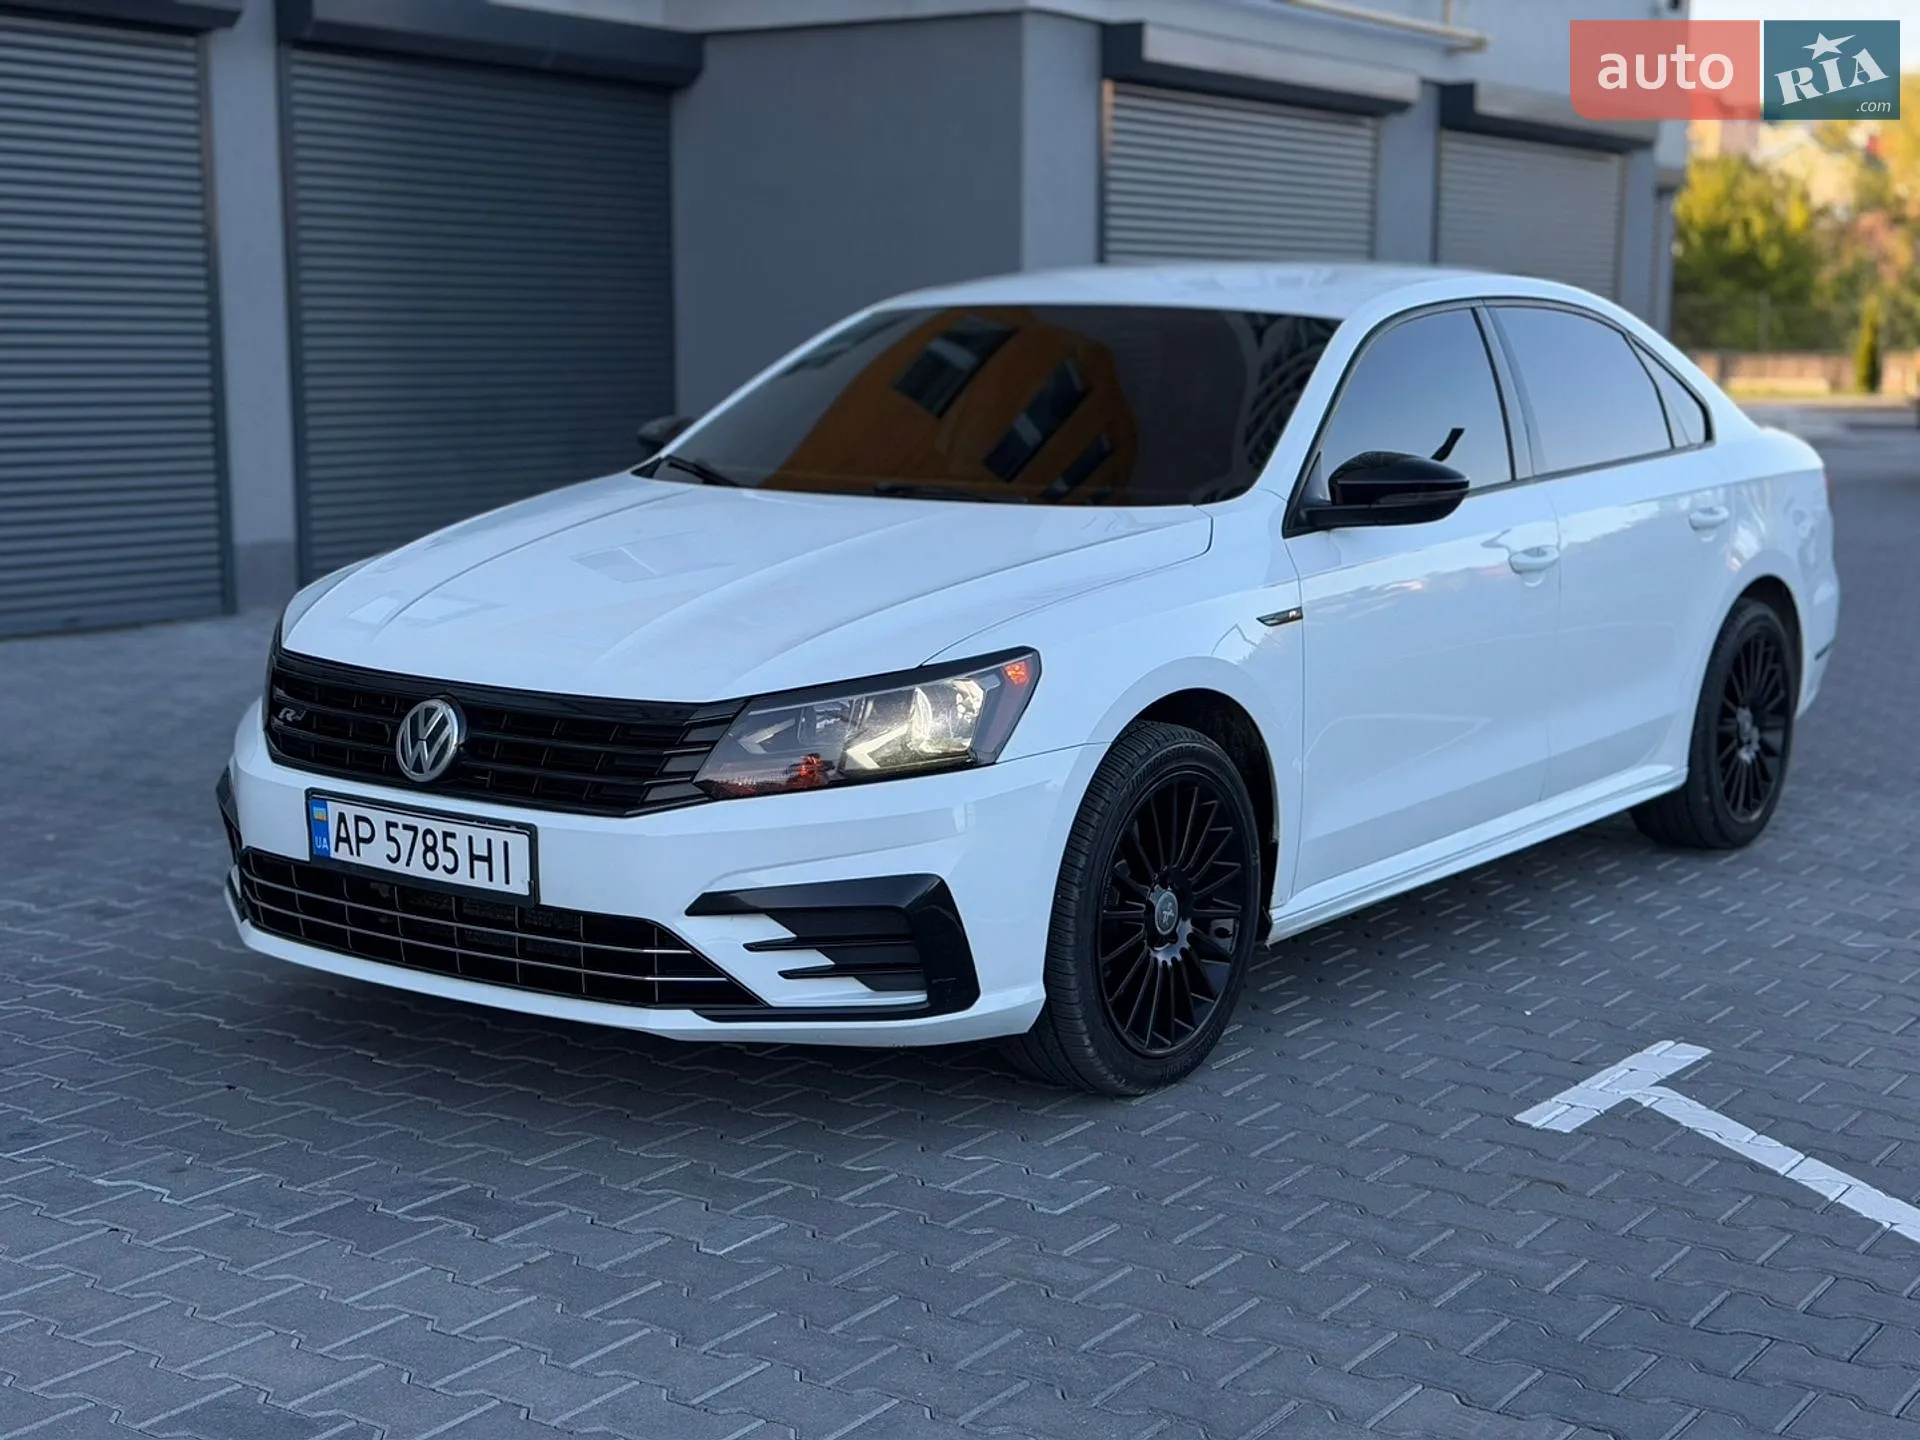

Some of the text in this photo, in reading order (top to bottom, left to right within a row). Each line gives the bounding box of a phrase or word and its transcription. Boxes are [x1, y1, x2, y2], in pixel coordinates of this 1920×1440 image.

[314, 836, 329, 850] UA
[334, 811, 510, 885] AP 5785 HI
